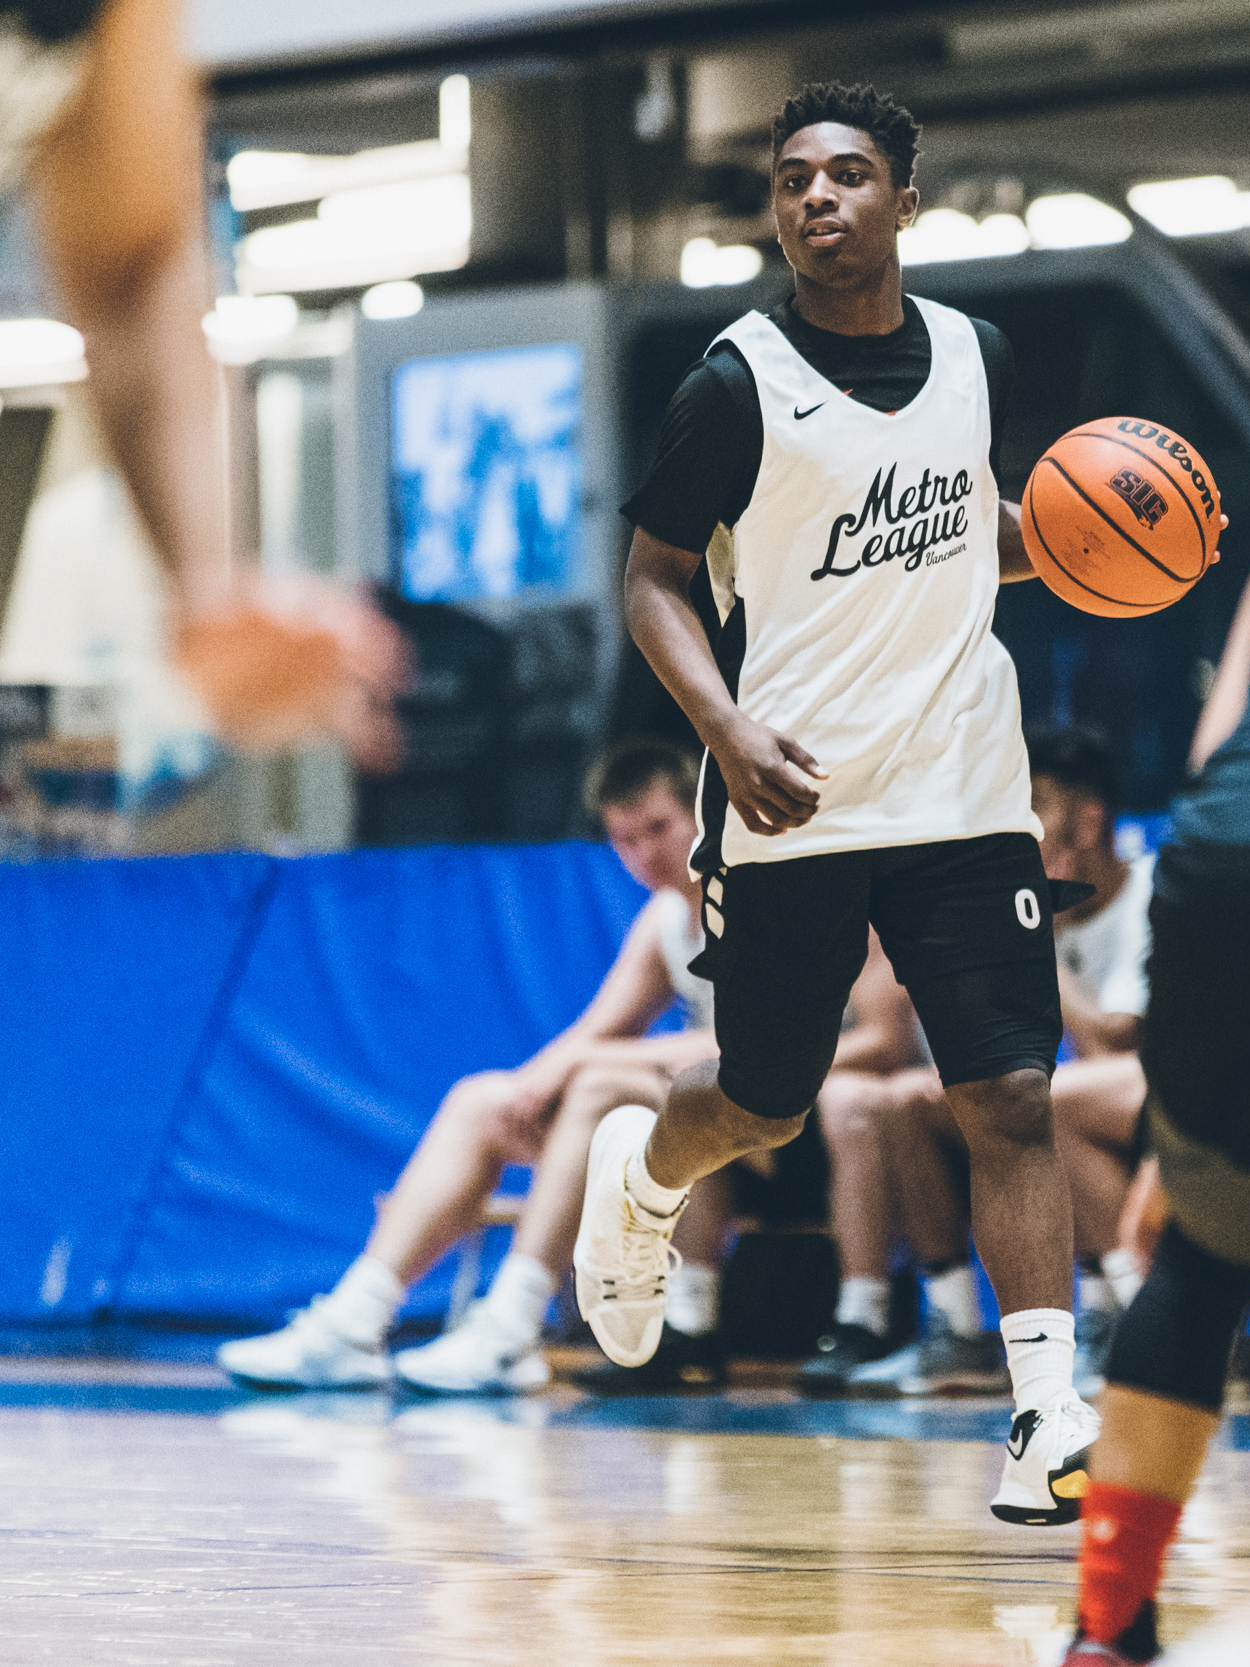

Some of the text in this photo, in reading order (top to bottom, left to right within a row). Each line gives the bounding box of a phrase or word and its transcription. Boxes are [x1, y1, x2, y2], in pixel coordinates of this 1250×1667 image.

[844, 461, 973, 537] Metro
[810, 505, 968, 581] League
[1015, 888, 1041, 930] 0
